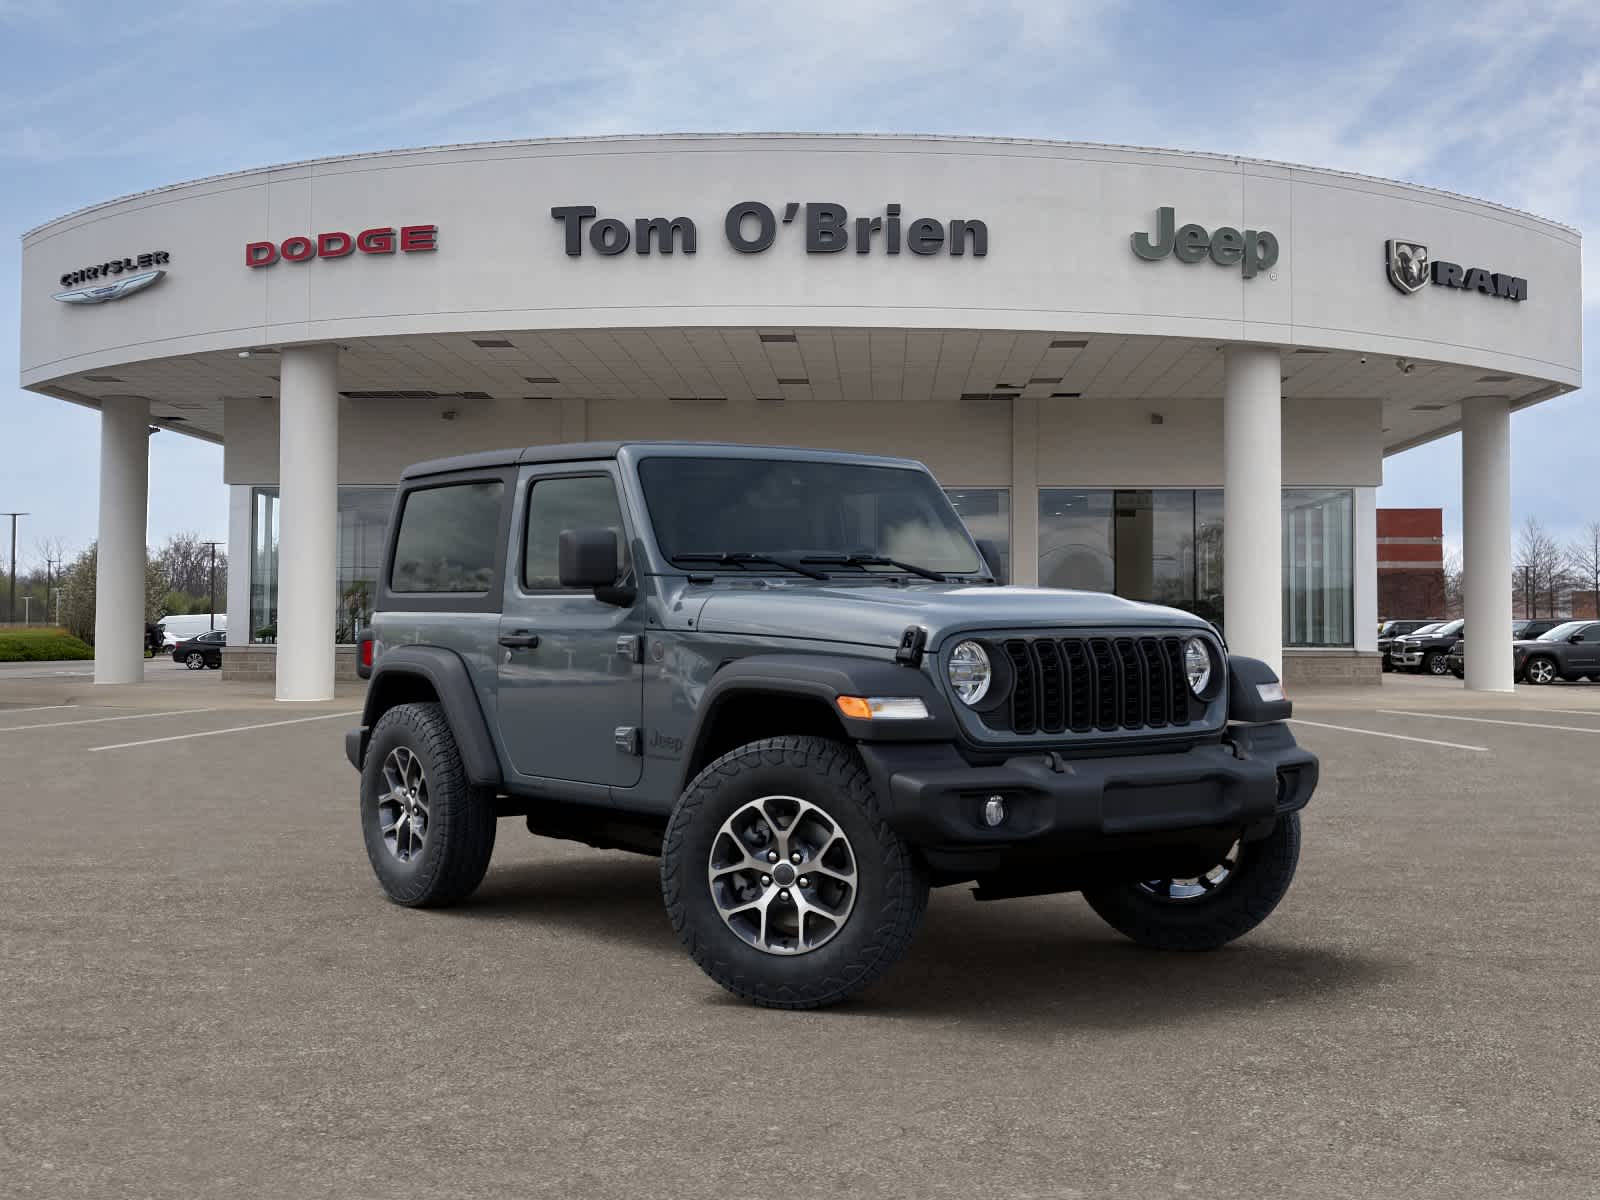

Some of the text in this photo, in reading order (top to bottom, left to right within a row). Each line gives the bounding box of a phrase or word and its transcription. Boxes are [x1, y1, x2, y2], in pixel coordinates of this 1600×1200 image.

[245, 225, 440, 269] DODGE
[550, 205, 697, 257] Tom
[1130, 206, 1280, 280] Jeep
[60, 250, 170, 286] CHRYSLER
[1430, 260, 1528, 301] RAM
